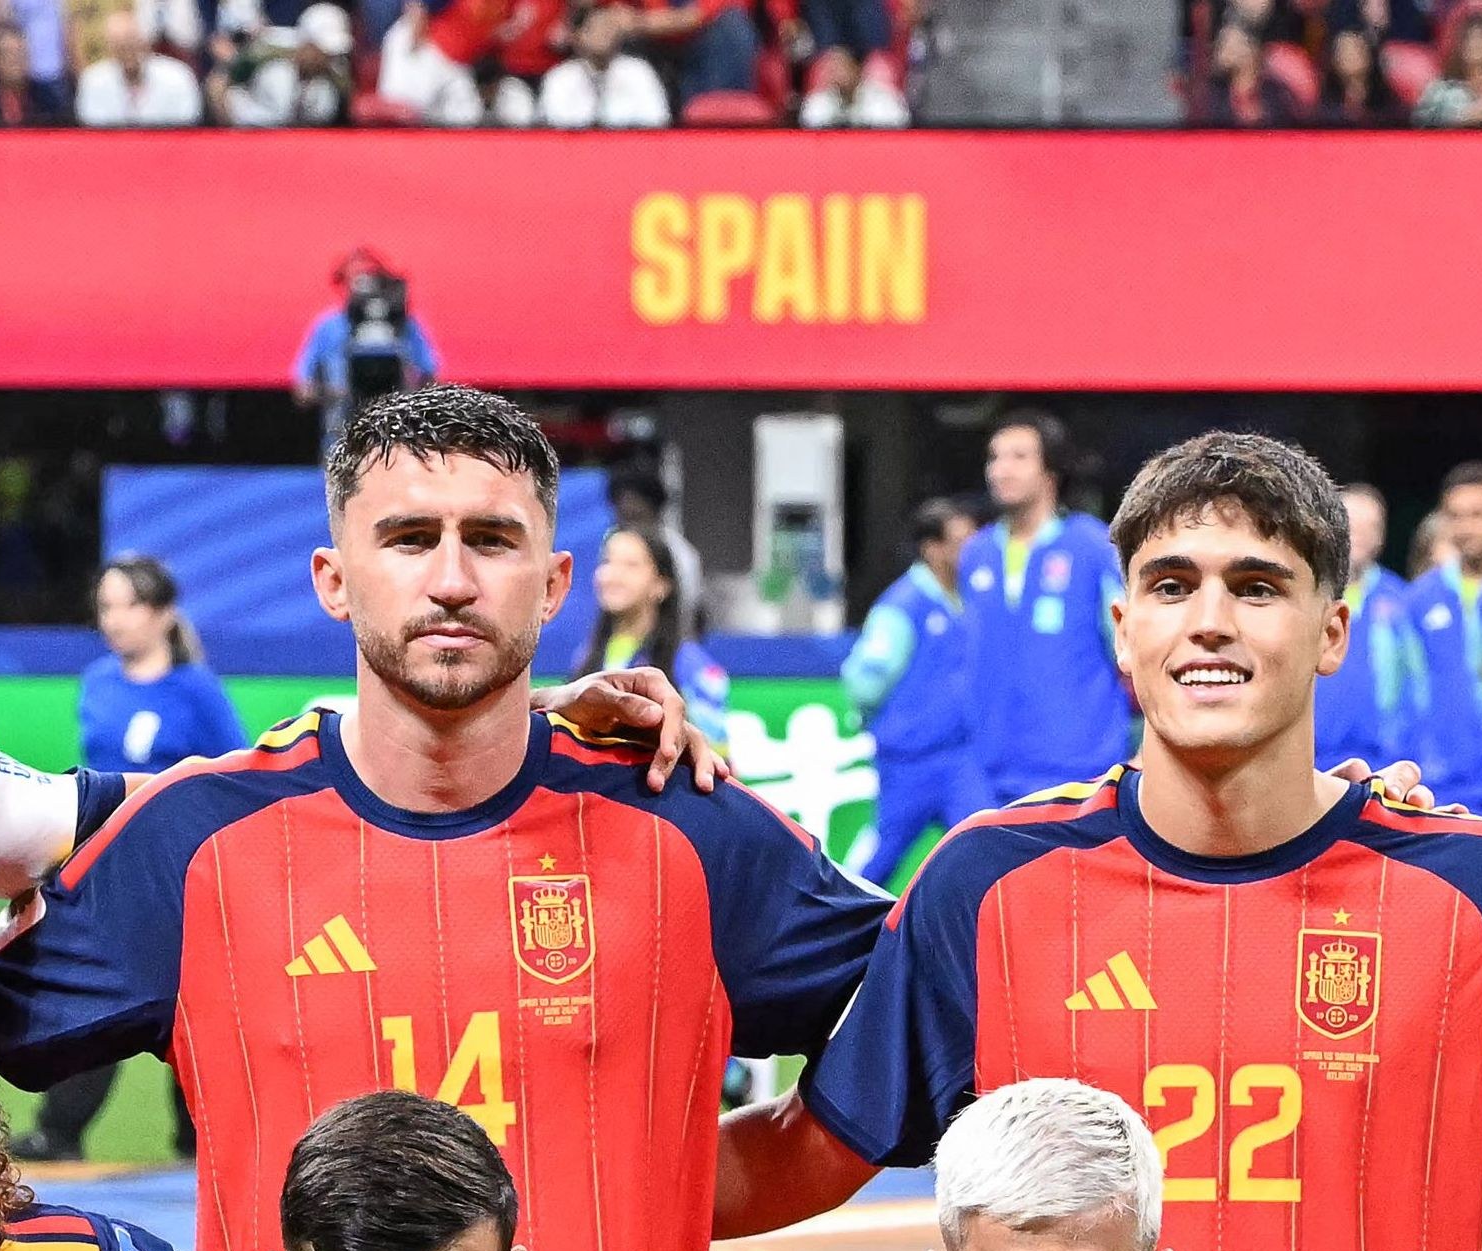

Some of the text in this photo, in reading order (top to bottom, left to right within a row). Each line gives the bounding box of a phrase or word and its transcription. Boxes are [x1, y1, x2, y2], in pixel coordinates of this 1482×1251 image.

[631, 193, 927, 323] SPAIN
[382, 1012, 517, 1146] 14
[1143, 1064, 1303, 1203] 22
